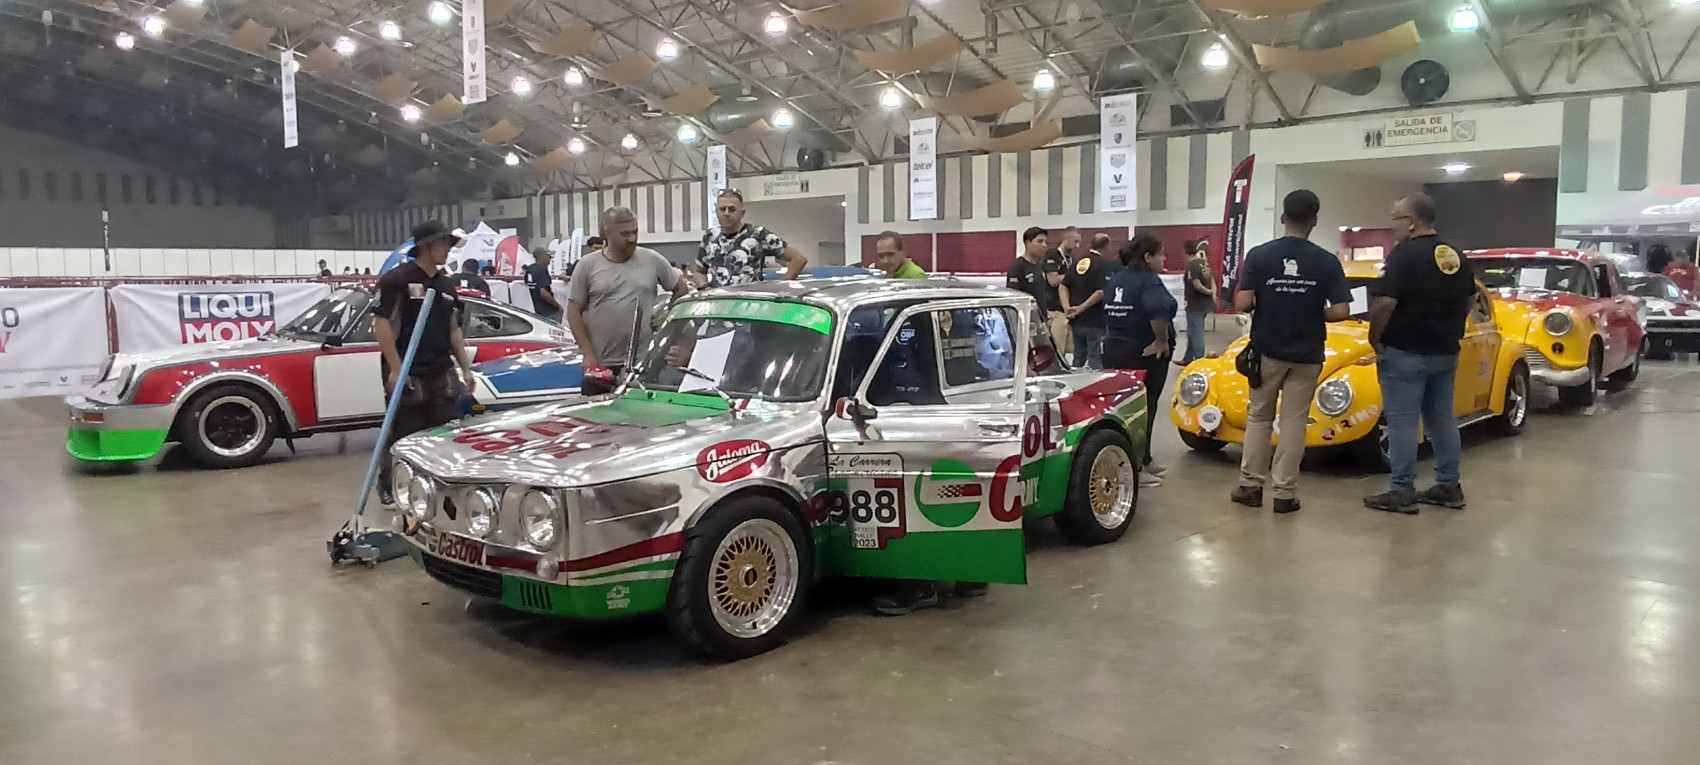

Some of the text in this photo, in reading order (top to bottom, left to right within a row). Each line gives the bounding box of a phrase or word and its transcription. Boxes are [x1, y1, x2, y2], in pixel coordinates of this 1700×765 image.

[1394, 116, 1443, 128] SALIDA DE
[1387, 126, 1449, 137] EMERGENCIA
[183, 293, 271, 319] LIQUI
[185, 320, 274, 342] MOLY
[849, 455, 892, 467] Carrera
[438, 532, 485, 566] Castrol
[854, 539, 876, 547] 2023
